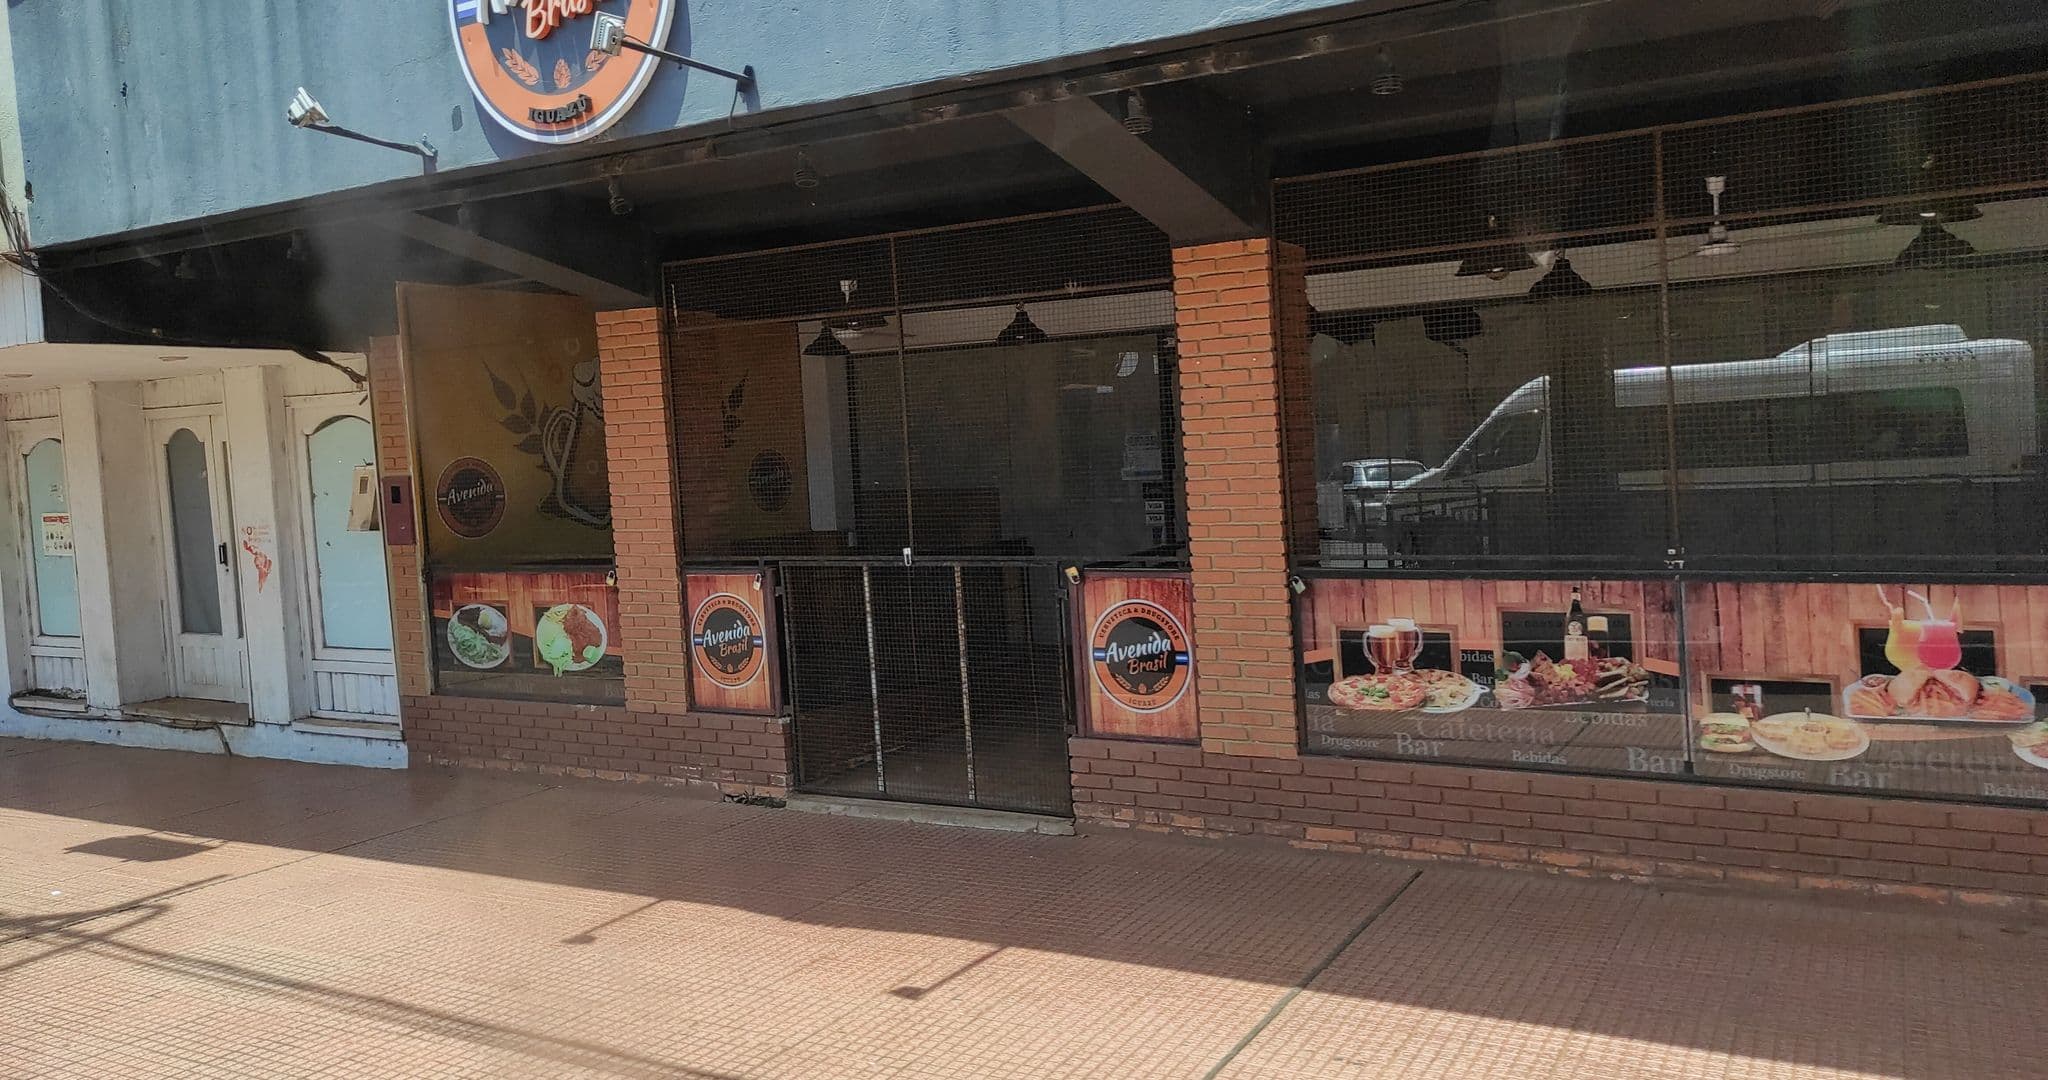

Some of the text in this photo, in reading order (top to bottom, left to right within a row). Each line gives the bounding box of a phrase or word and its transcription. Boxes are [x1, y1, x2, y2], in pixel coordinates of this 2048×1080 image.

[447, 478, 494, 506] Avenida
[703, 619, 751, 648] Avenida
[1141, 607, 1180, 641] DRUGSTORE
[719, 636, 748, 657] Brasil
[1106, 631, 1172, 665] Avenida
[1127, 652, 1169, 675] Brasil
[1472, 672, 1495, 685] Bar
[1320, 734, 1380, 750] Drugstore
[1393, 731, 1445, 758] Bar
[1511, 748, 1568, 765] Bebidas
[1626, 745, 1682, 774] Bar
[1729, 762, 1806, 783] Drugstore
